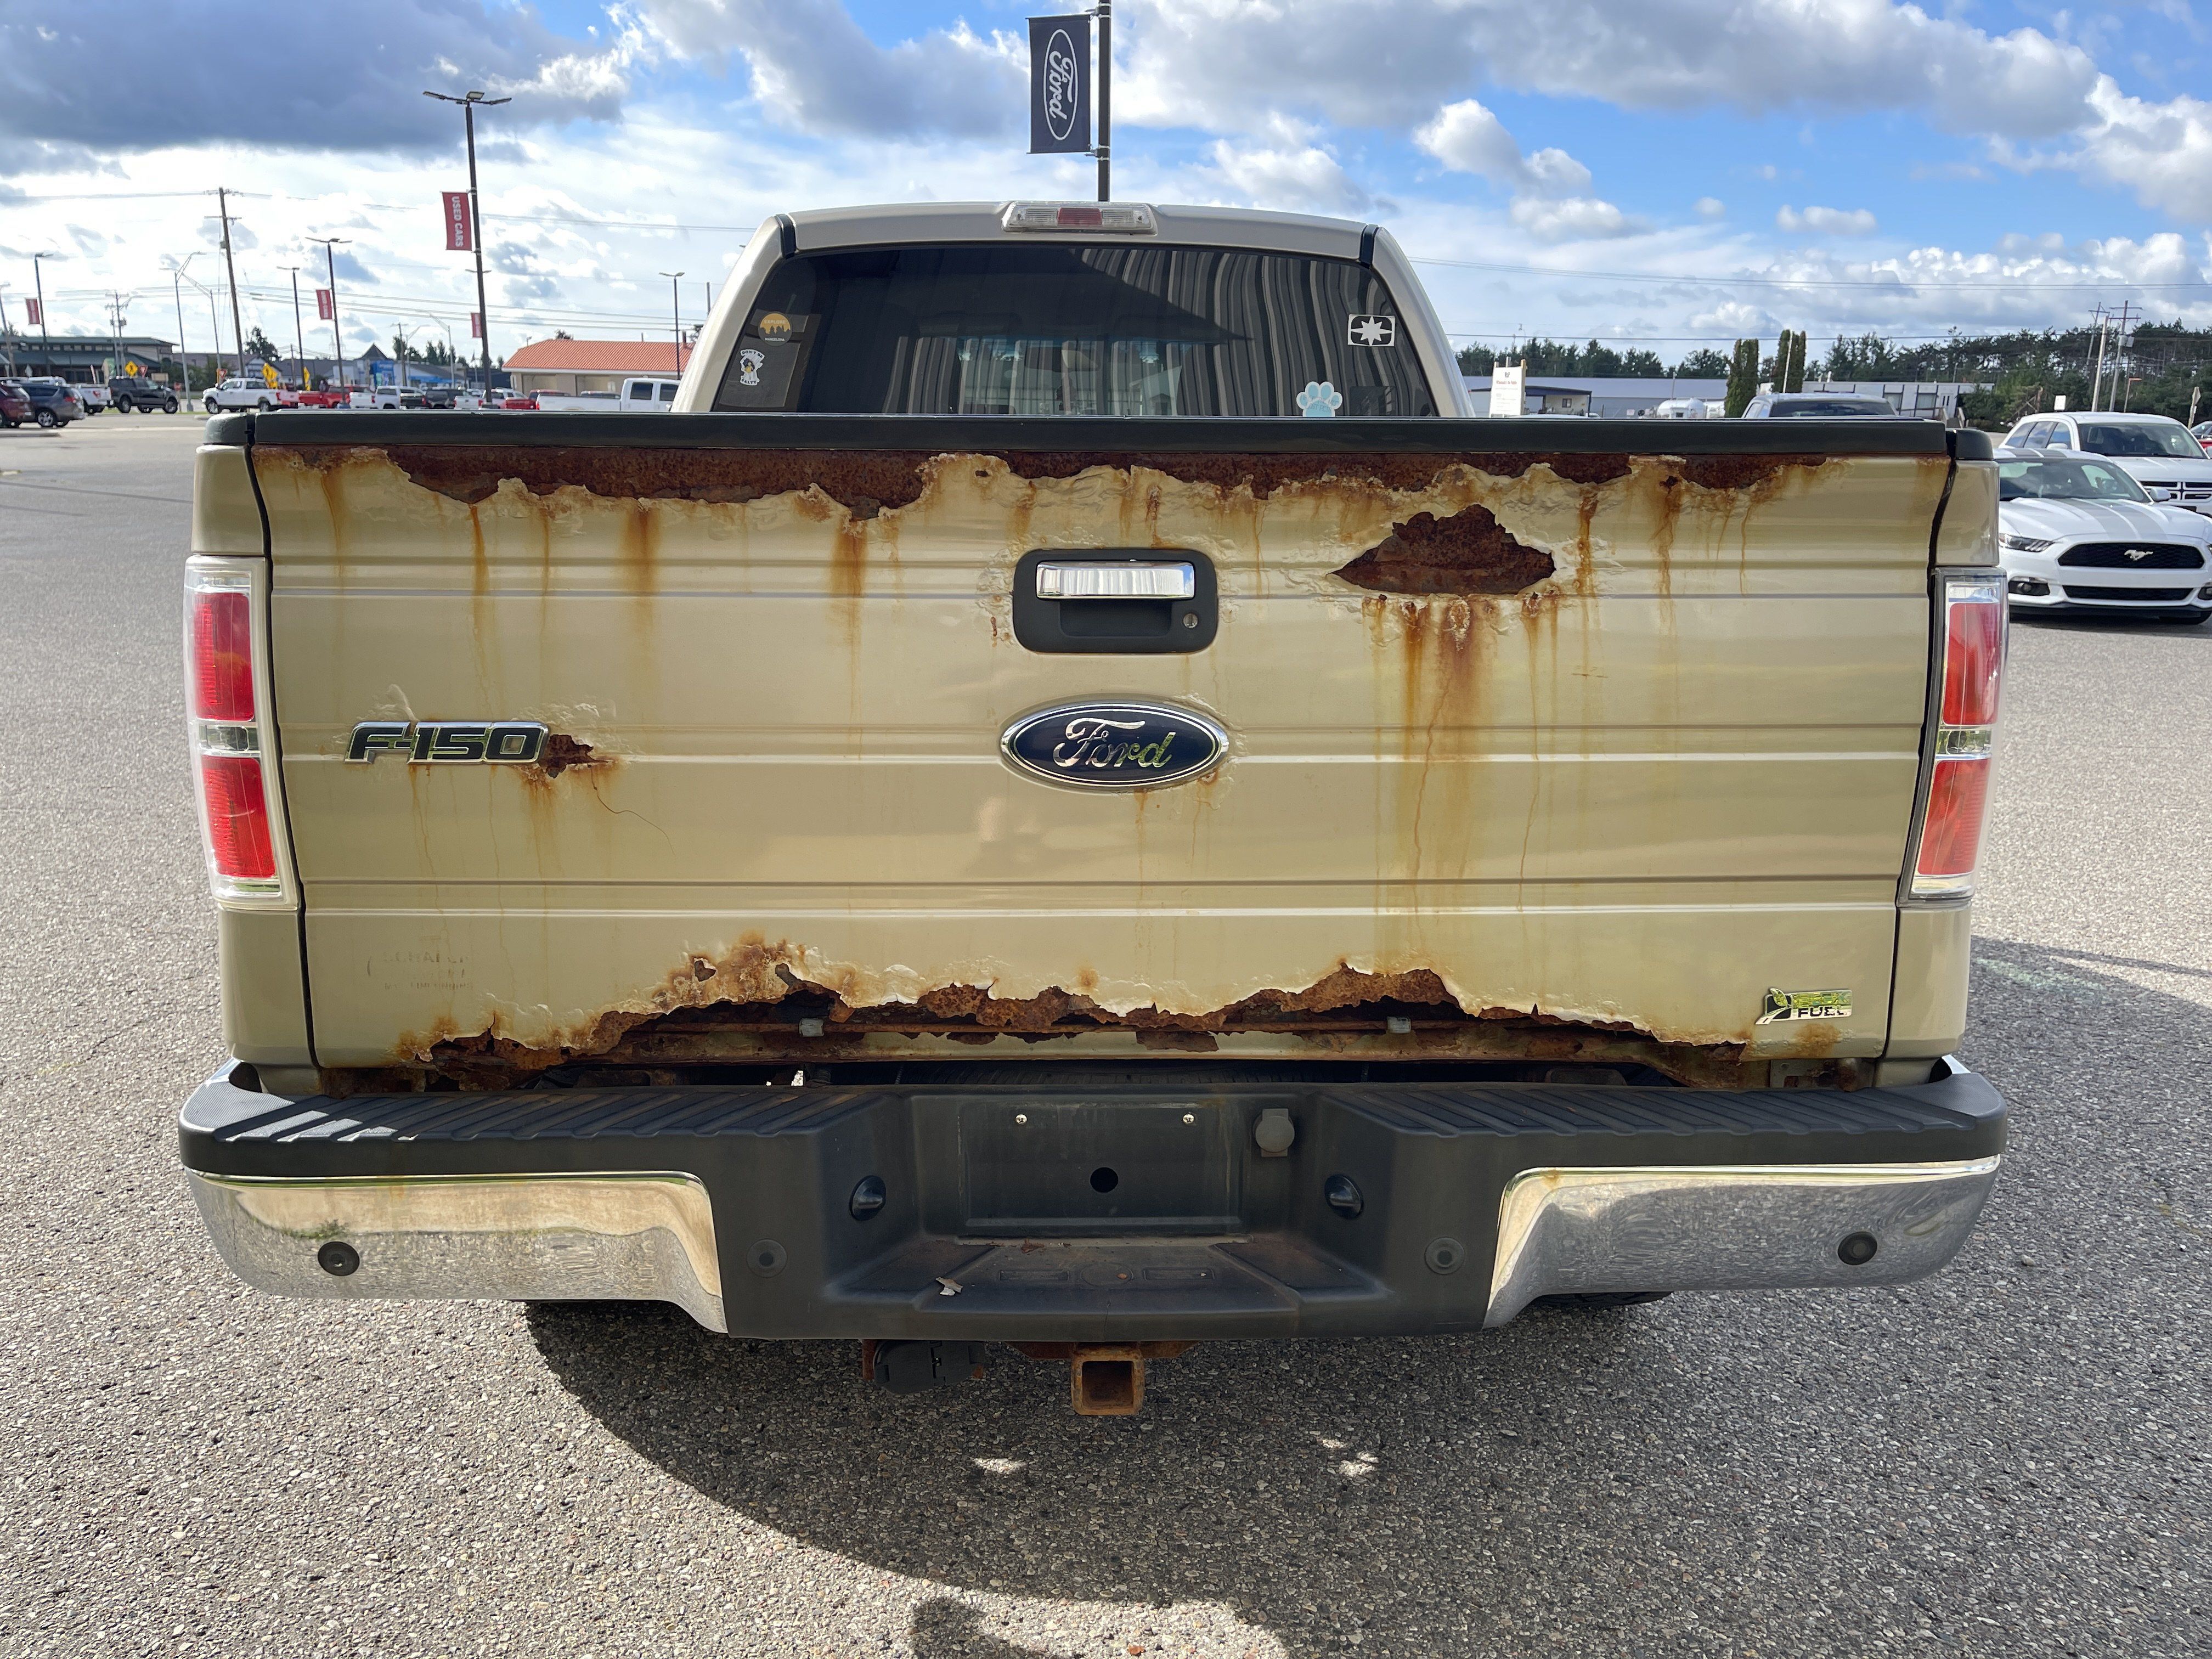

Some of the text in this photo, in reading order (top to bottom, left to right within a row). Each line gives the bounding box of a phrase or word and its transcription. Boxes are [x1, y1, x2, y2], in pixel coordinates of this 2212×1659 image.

[1049, 50, 1074, 120] Ford
[452, 196, 464, 247] USED CARS
[343, 721, 549, 764] F-150
[1052, 717, 1176, 768] Ford
[1798, 1005, 1846, 1018] FUEL
